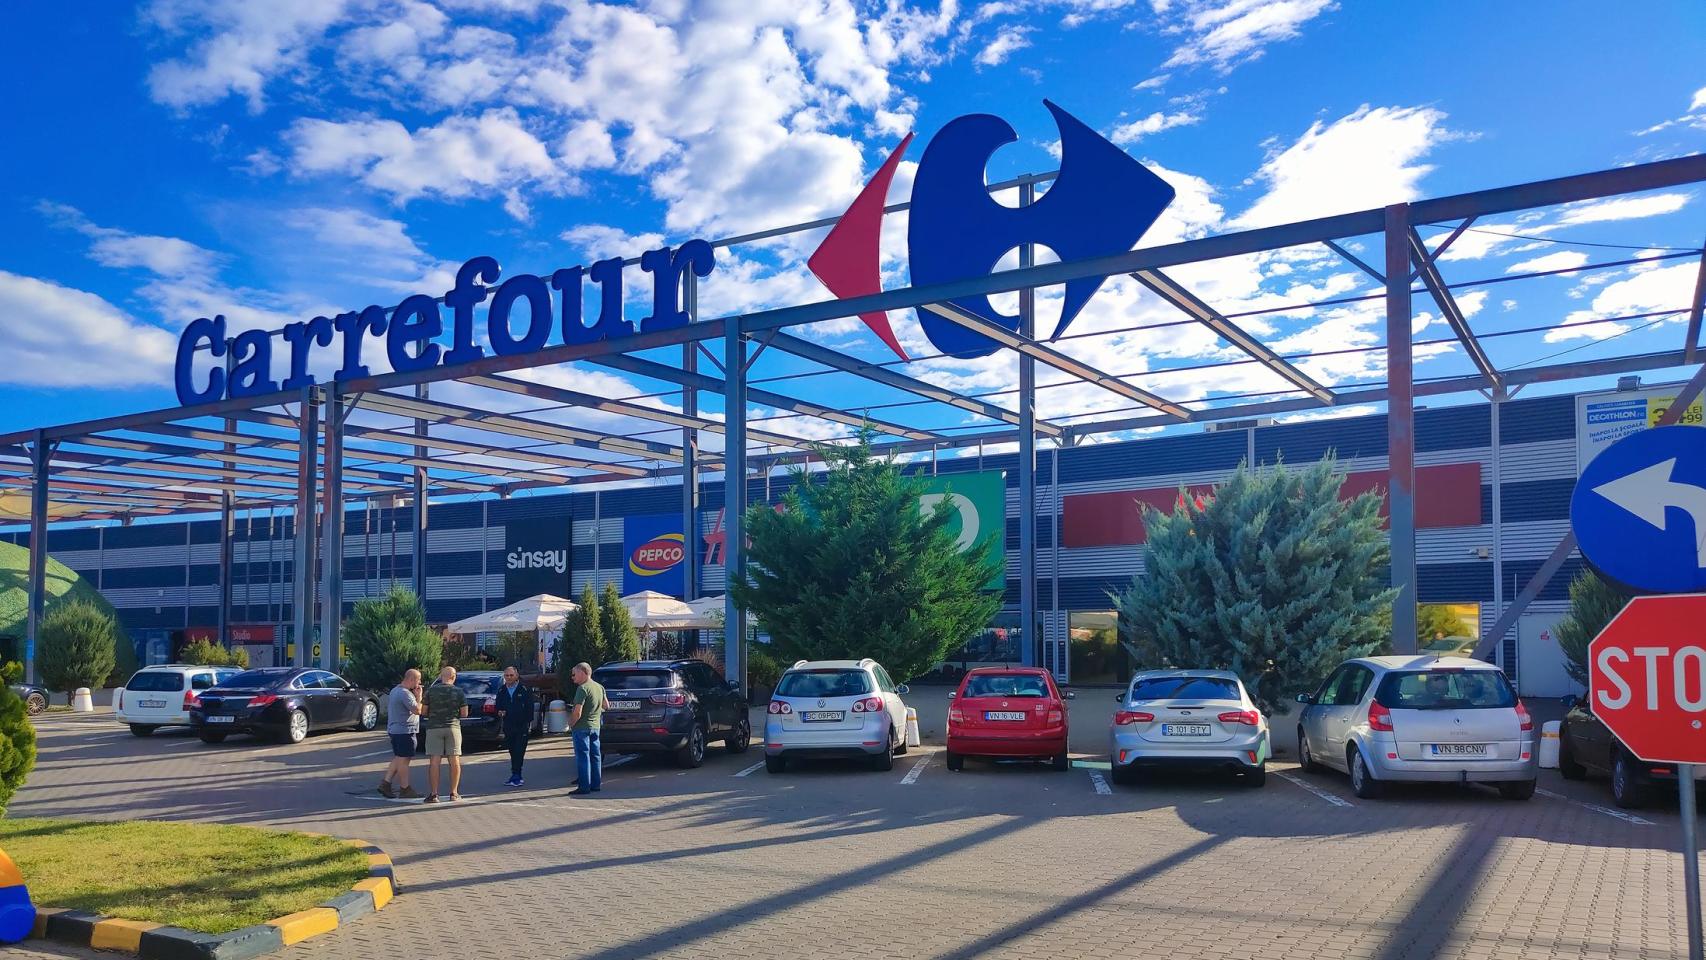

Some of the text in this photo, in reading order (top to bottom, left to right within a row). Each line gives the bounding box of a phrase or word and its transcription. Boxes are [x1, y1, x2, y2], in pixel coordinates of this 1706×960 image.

[174, 239, 716, 407] Carrefour
[506, 547, 567, 574] sinsay
[638, 547, 682, 562] PEPCO
[232, 629, 251, 641] Studio
[990, 712, 1000, 720] VN
[1010, 712, 1024, 720] VLE
[1167, 726, 1174, 734] B
[1438, 745, 1452, 753] VN
